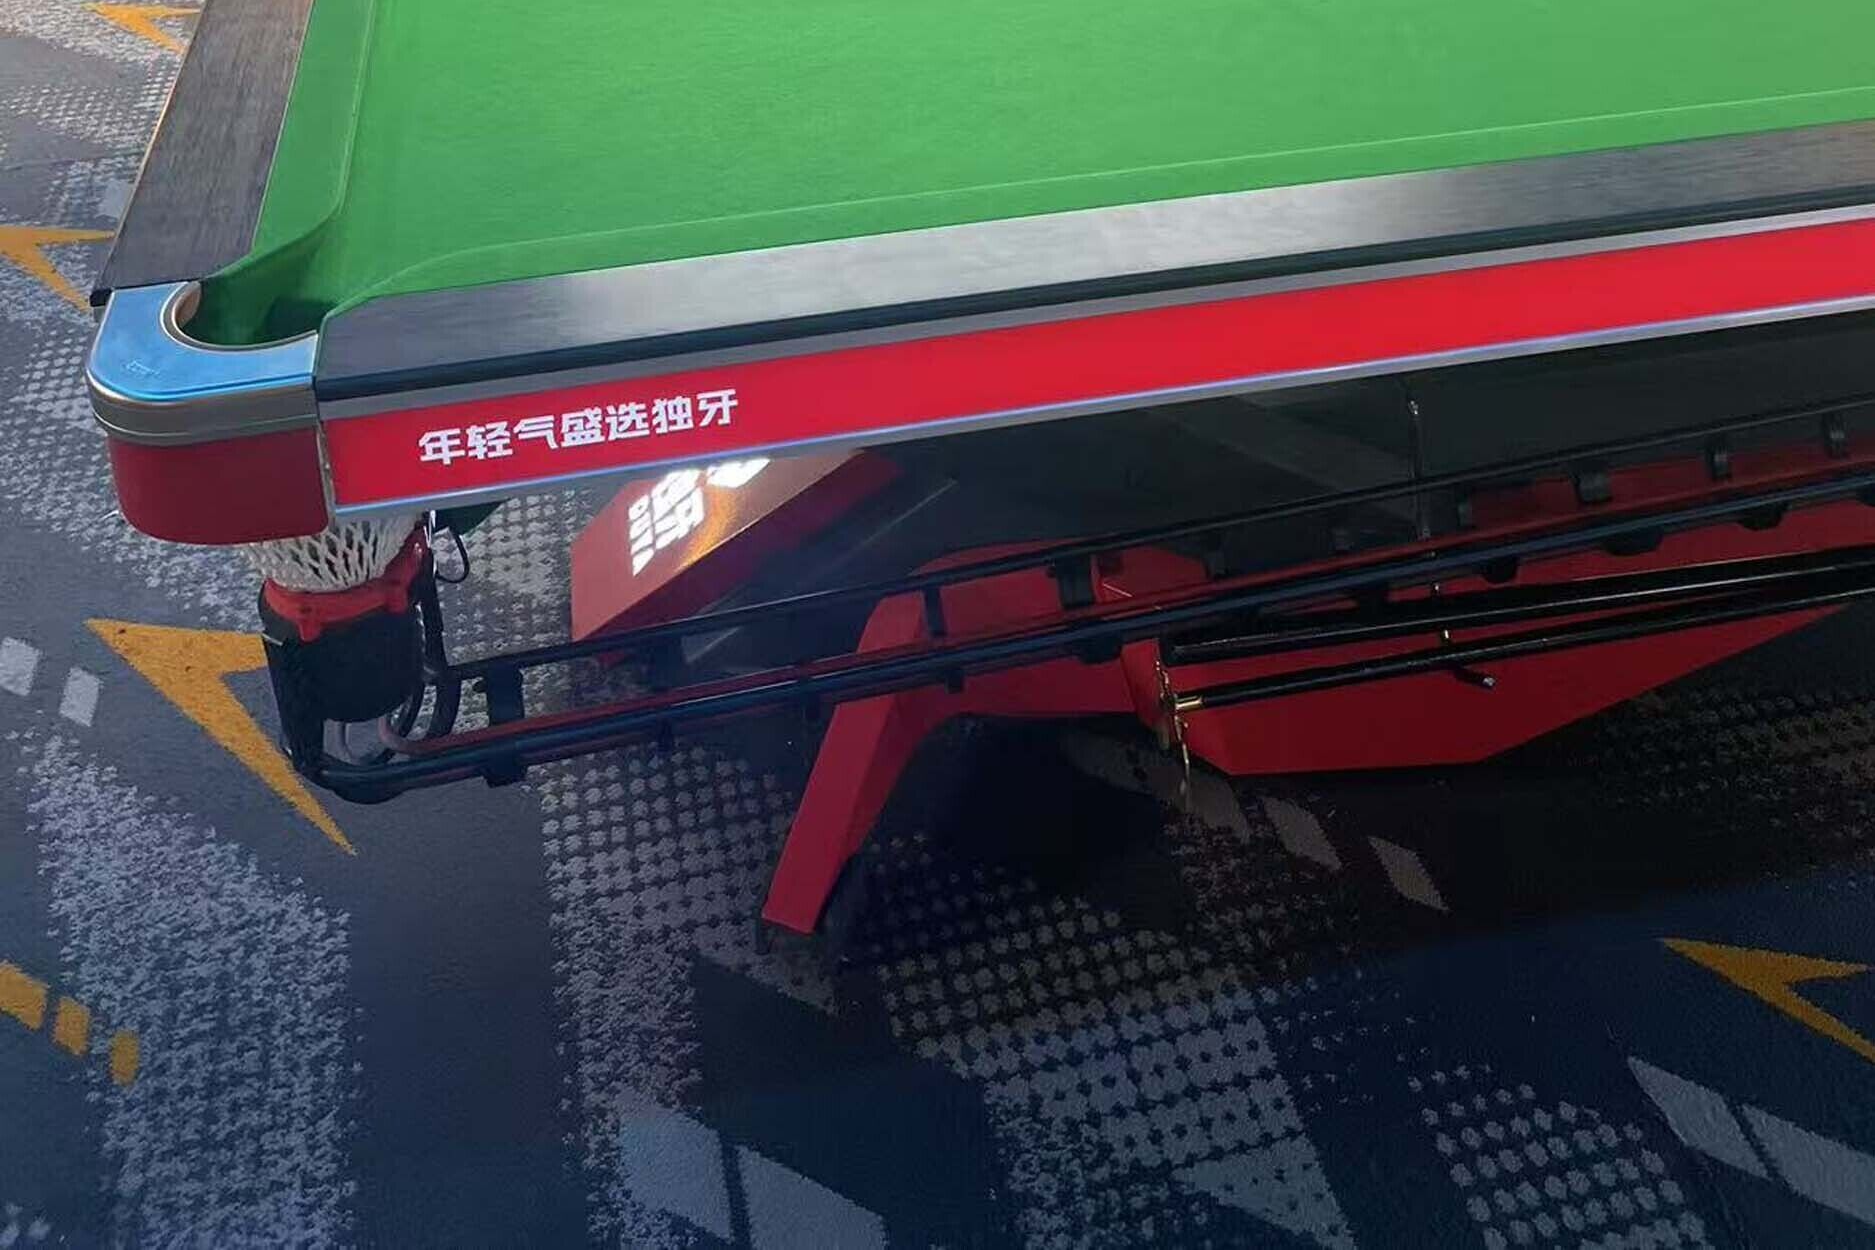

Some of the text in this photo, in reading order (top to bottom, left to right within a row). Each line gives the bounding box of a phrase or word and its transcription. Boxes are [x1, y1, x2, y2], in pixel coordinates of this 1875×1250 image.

[418, 388, 738, 465] 年轻气盛选独牙
